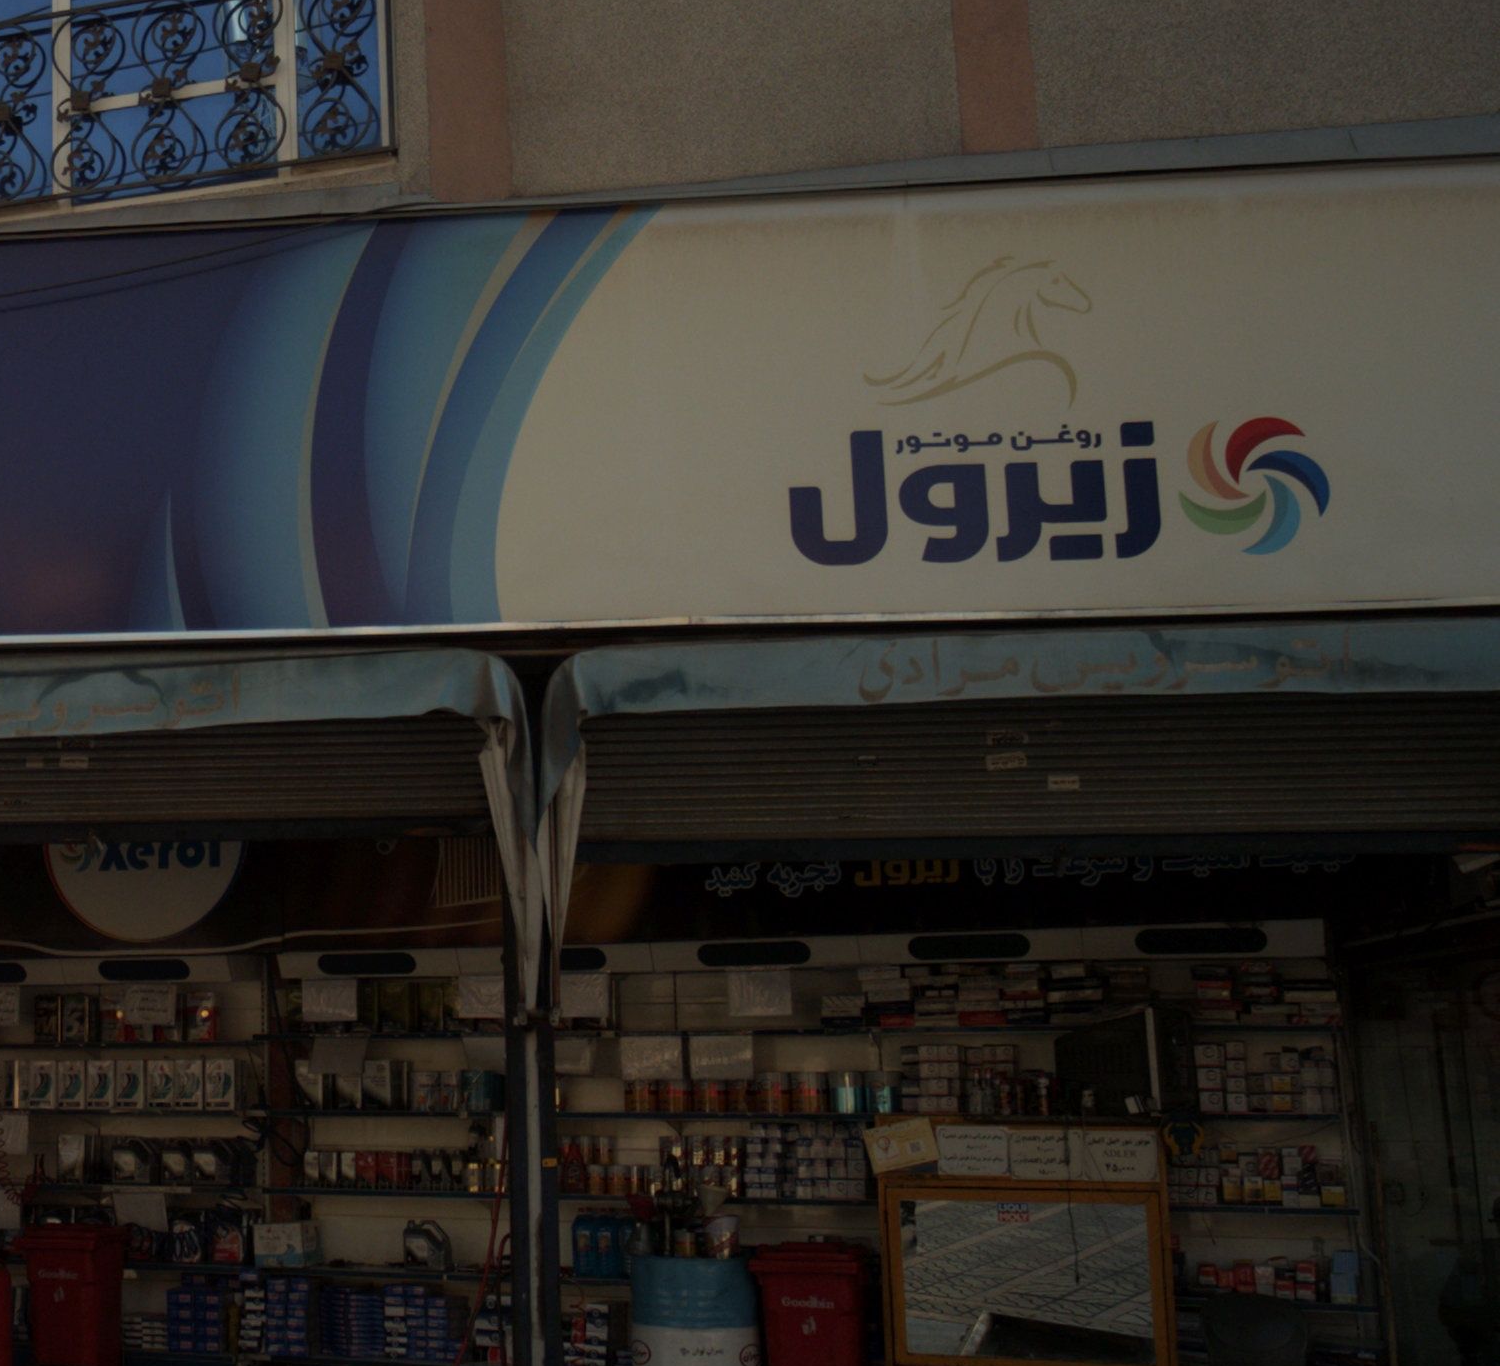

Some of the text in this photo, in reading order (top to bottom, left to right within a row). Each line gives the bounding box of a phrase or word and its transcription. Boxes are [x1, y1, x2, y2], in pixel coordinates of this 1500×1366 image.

[896, 424, 1102, 453] روغن موتور
[788, 420, 1162, 566] زیرول
